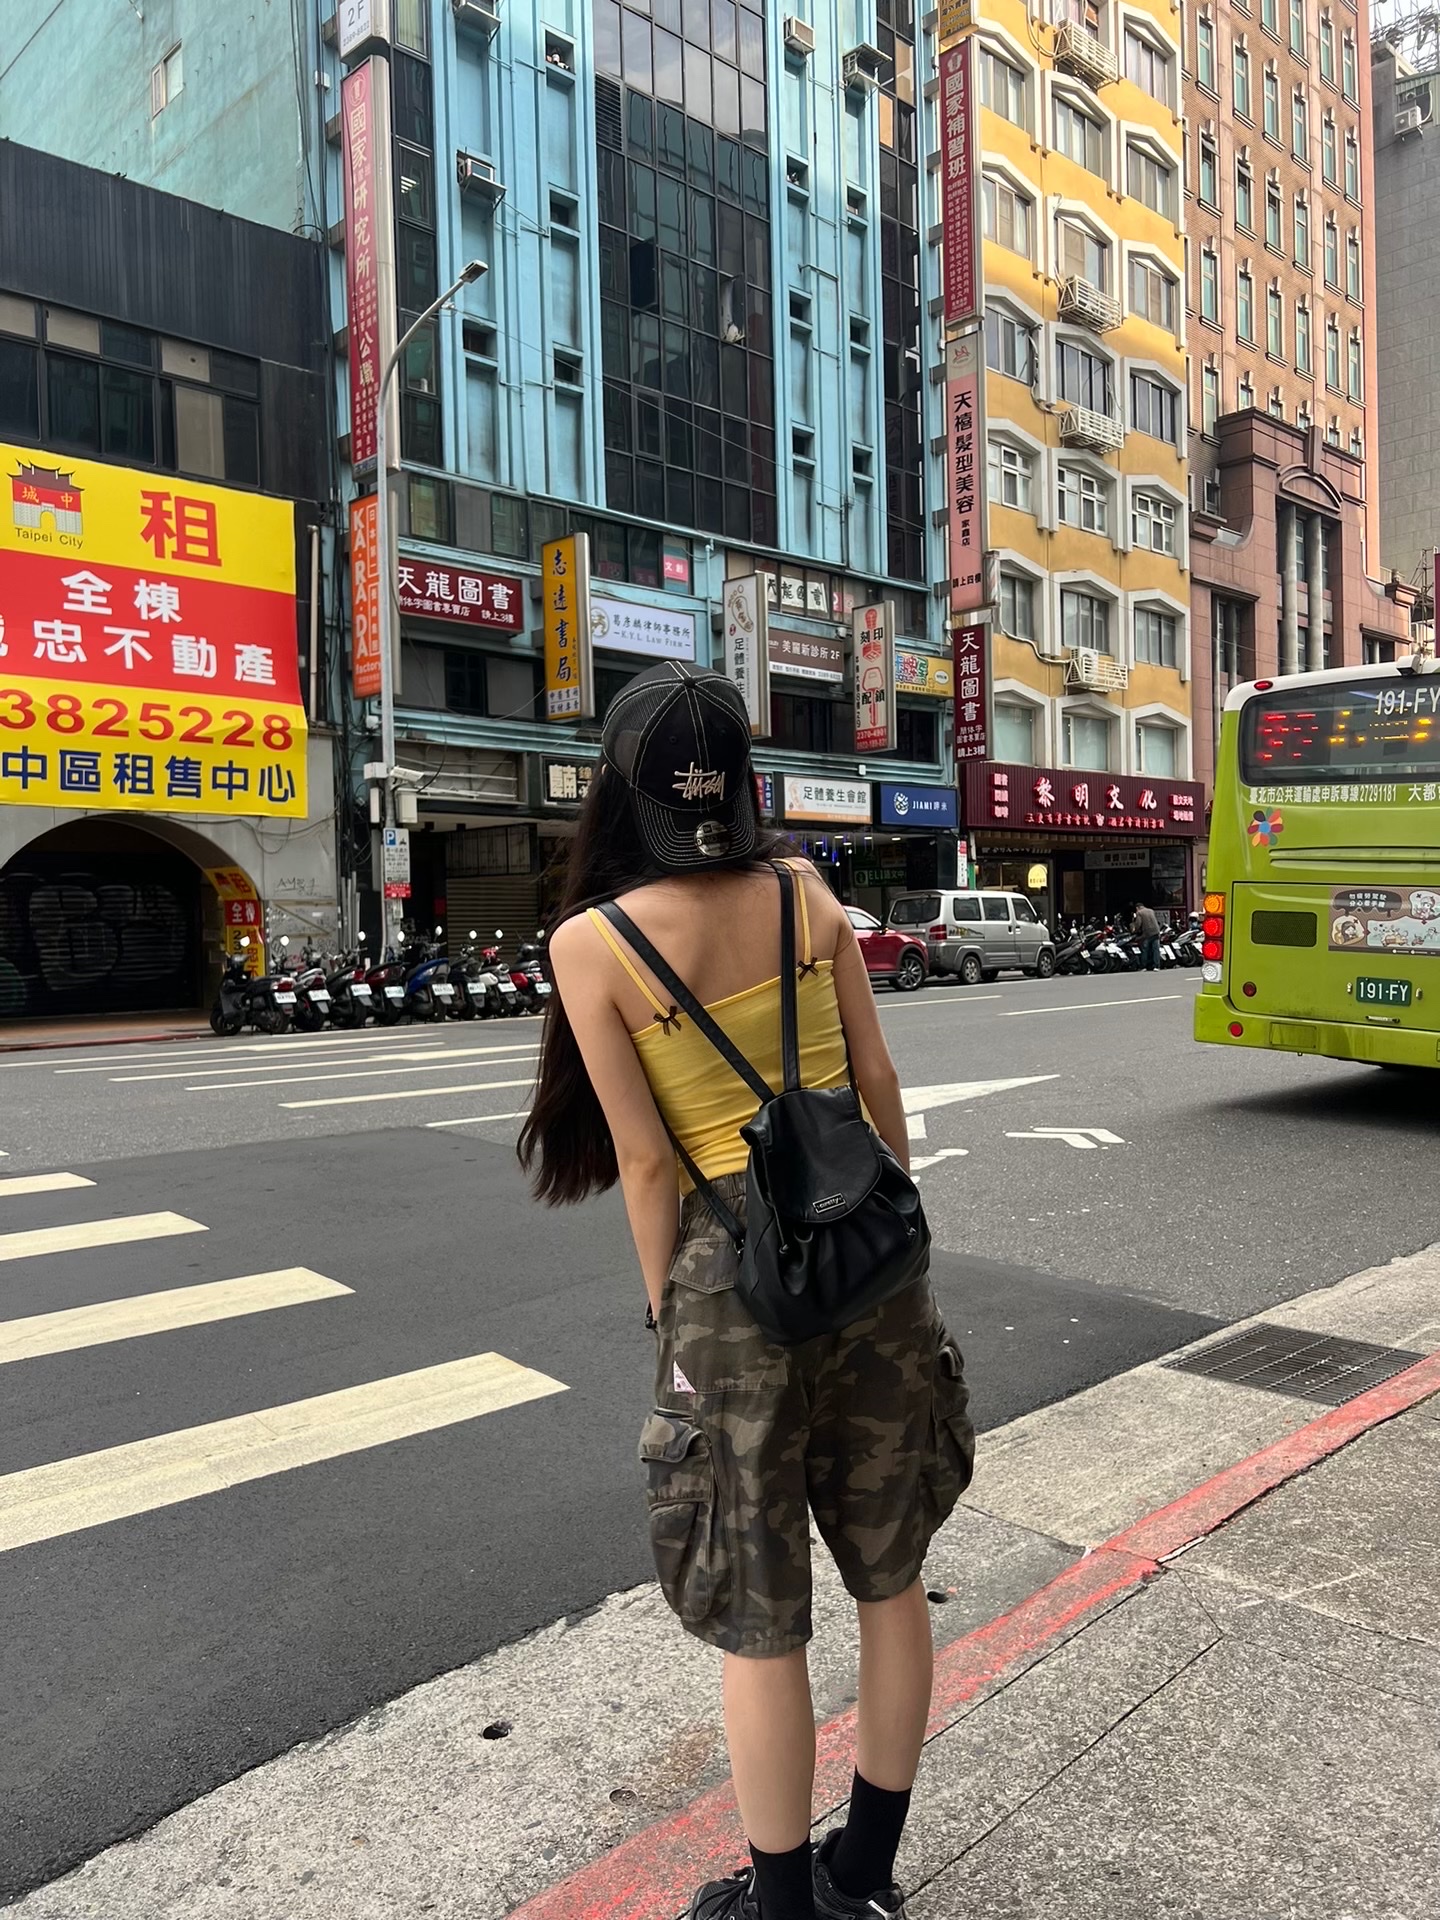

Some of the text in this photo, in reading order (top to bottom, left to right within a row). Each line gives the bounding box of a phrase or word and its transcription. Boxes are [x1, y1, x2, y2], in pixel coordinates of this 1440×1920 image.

[347, 0, 365, 27] 2F
[945, 70, 967, 180] 國家補習班
[953, 390, 975, 515] 天禧髮型美容
[15, 527, 84, 550] Taipei City
[140, 490, 223, 567] 租
[61, 570, 183, 624] 全棟
[399, 566, 514, 610] 天龍圖書
[0, 615, 277, 686] 忠不動產
[733, 637, 746, 700] 足體養生
[830, 650, 840, 660] 2F
[960, 632, 981, 721] 天龍圖書
[0, 688, 294, 752] 3825228
[2, 745, 297, 803] 中區租售中心
[803, 786, 867, 804] 足體養生會館
[1034, 776, 1158, 810] 黎明文化
[1408, 783, 1440, 802] 大都
[386, 830, 395, 846] P
[1359, 981, 1409, 1002] 191-FY
